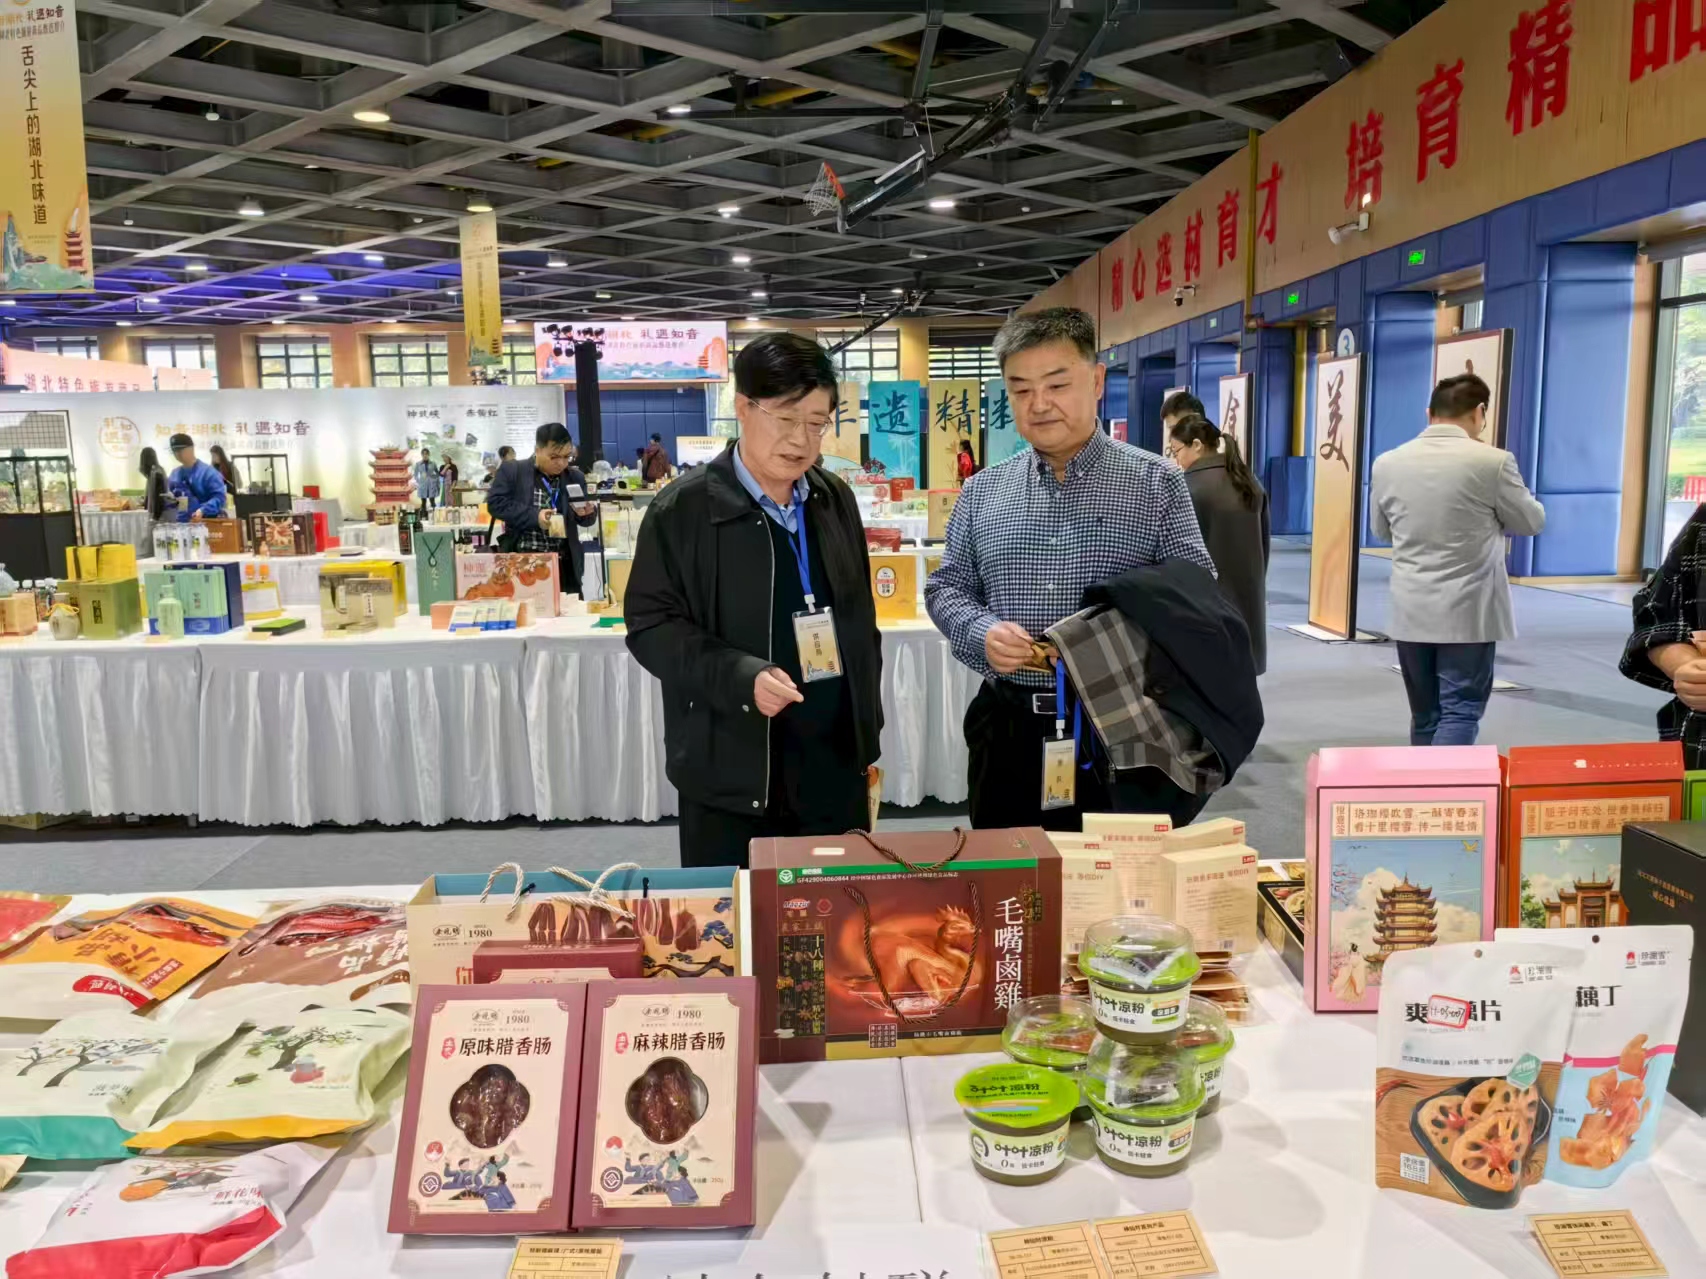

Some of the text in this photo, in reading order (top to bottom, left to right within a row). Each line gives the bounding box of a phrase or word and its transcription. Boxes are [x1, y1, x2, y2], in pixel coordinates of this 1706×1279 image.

[21, 45, 47, 225] 舌尖上的湖北味道
[641, 327, 700, 340] 礼遇知音
[871, 388, 919, 437] 遗
[934, 388, 976, 436] 精
[235, 419, 311, 437] 礼遇知音
[468, 929, 493, 938] 1980
[1575, 985, 1623, 1008] 藕丁
[506, 1015, 530, 1024] 1980
[677, 1009, 702, 1019] 1980
[459, 1036, 552, 1057] 原味腊香肠
[632, 1031, 726, 1052] 麻辣腊香肠
